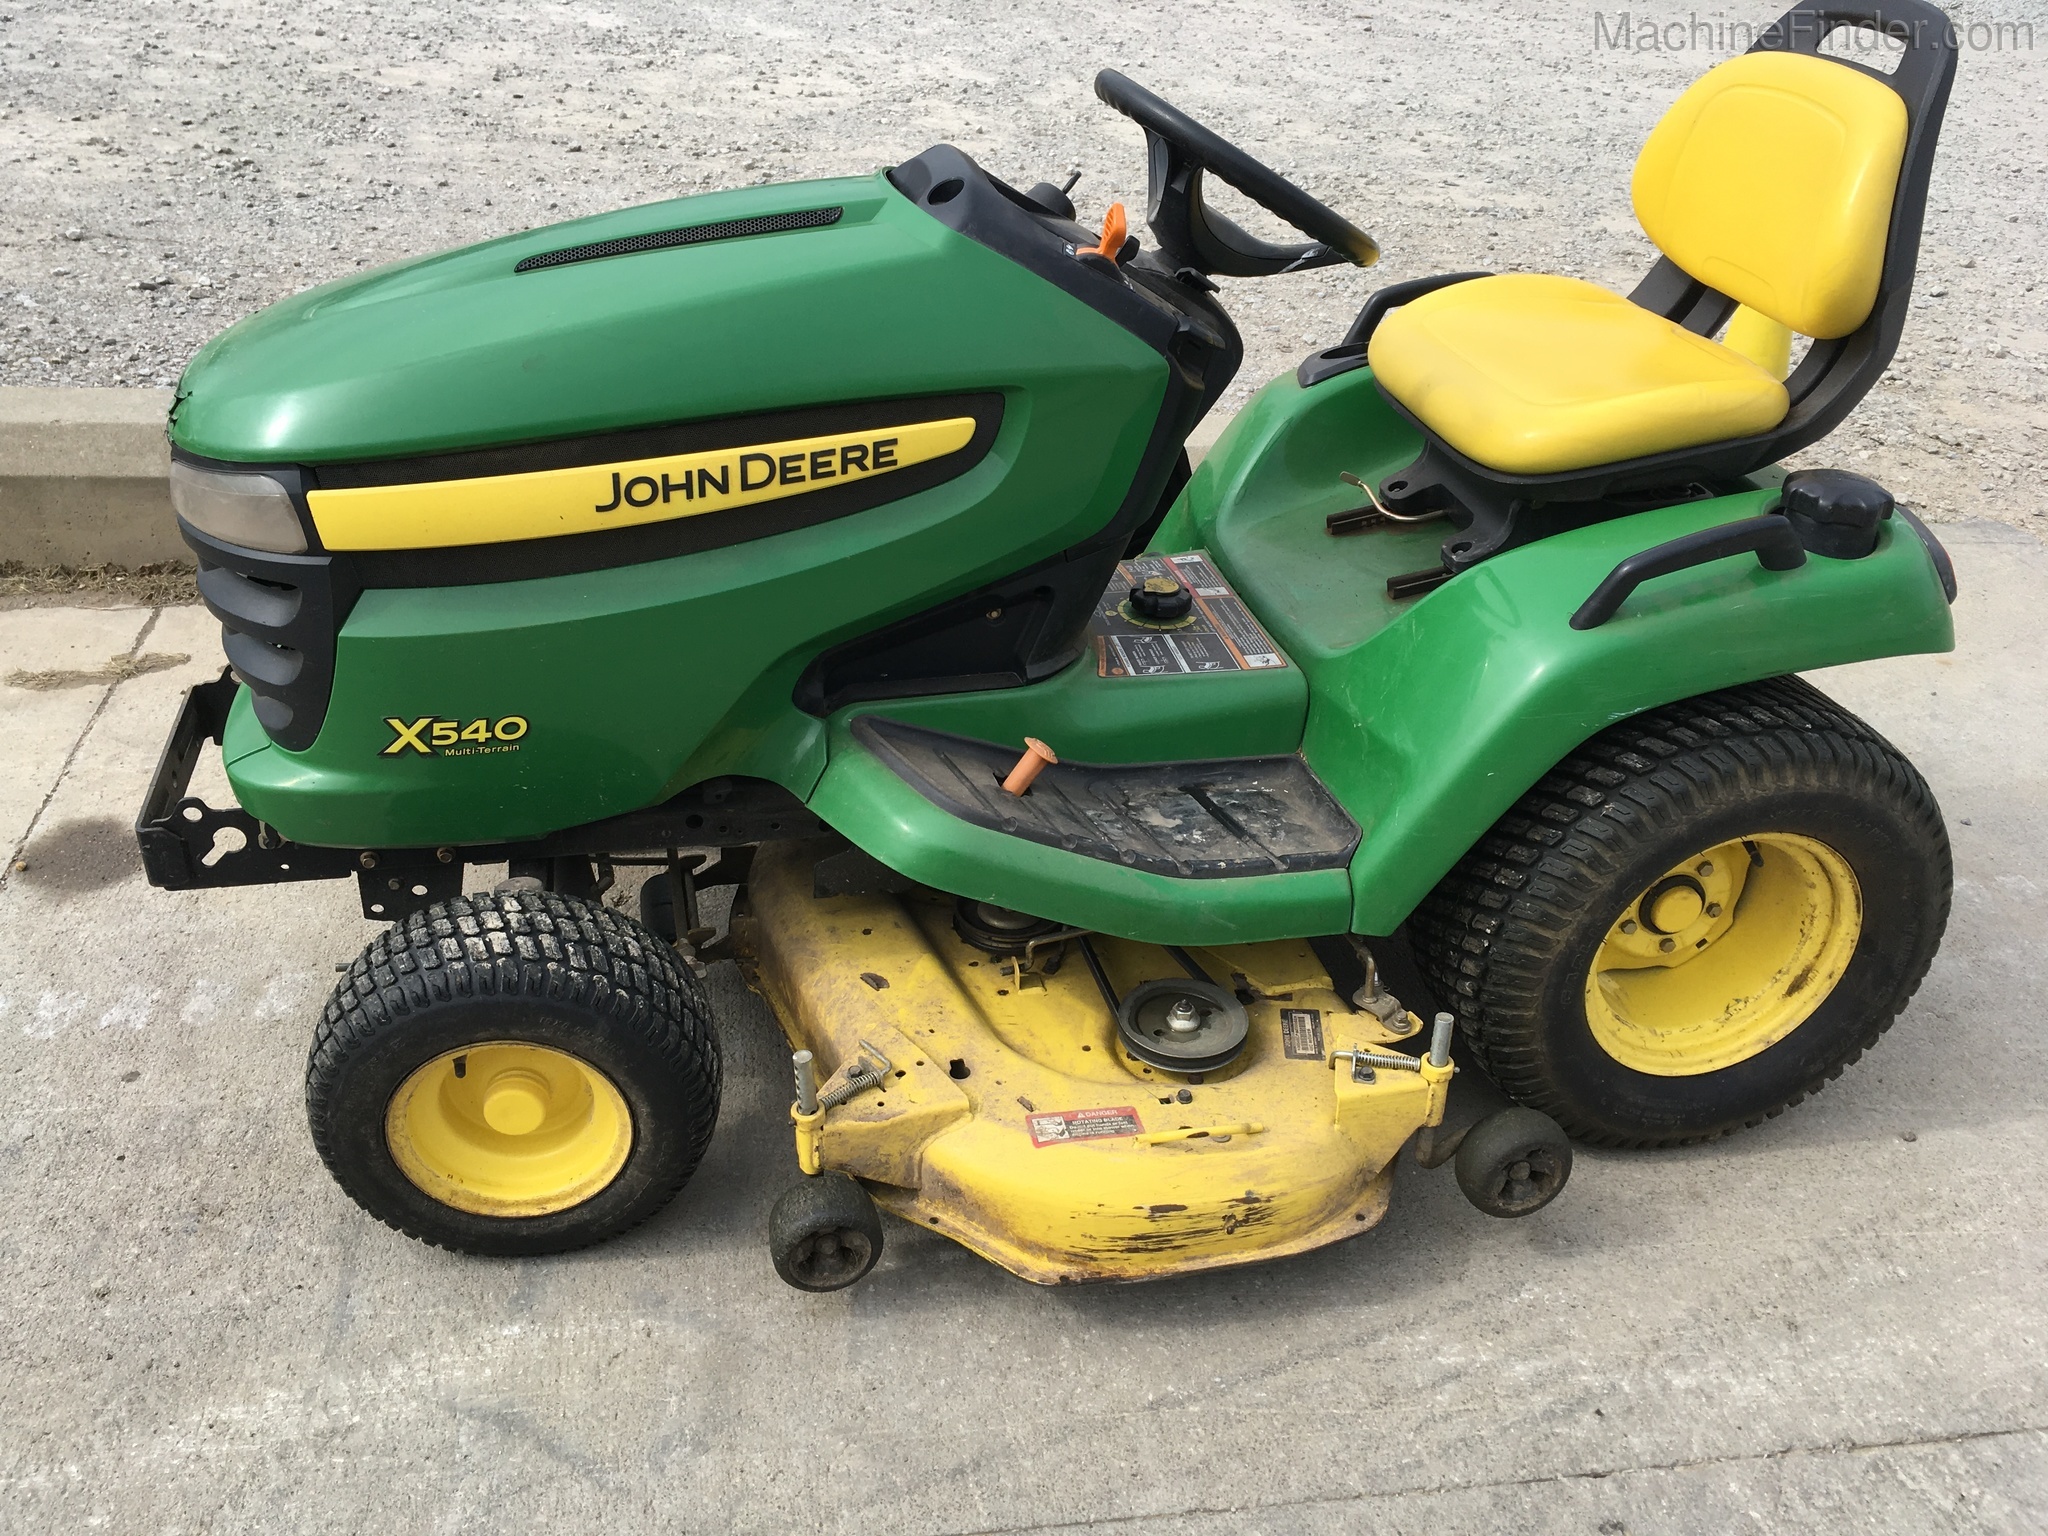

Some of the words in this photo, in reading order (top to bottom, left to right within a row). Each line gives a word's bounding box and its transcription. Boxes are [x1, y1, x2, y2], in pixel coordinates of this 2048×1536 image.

[595, 464, 730, 513] JOHN
[739, 437, 899, 492] DEERE
[377, 714, 530, 756] X540
[445, 743, 520, 757] Multi-Terrain
[1085, 1109, 1118, 1117] DANGER
